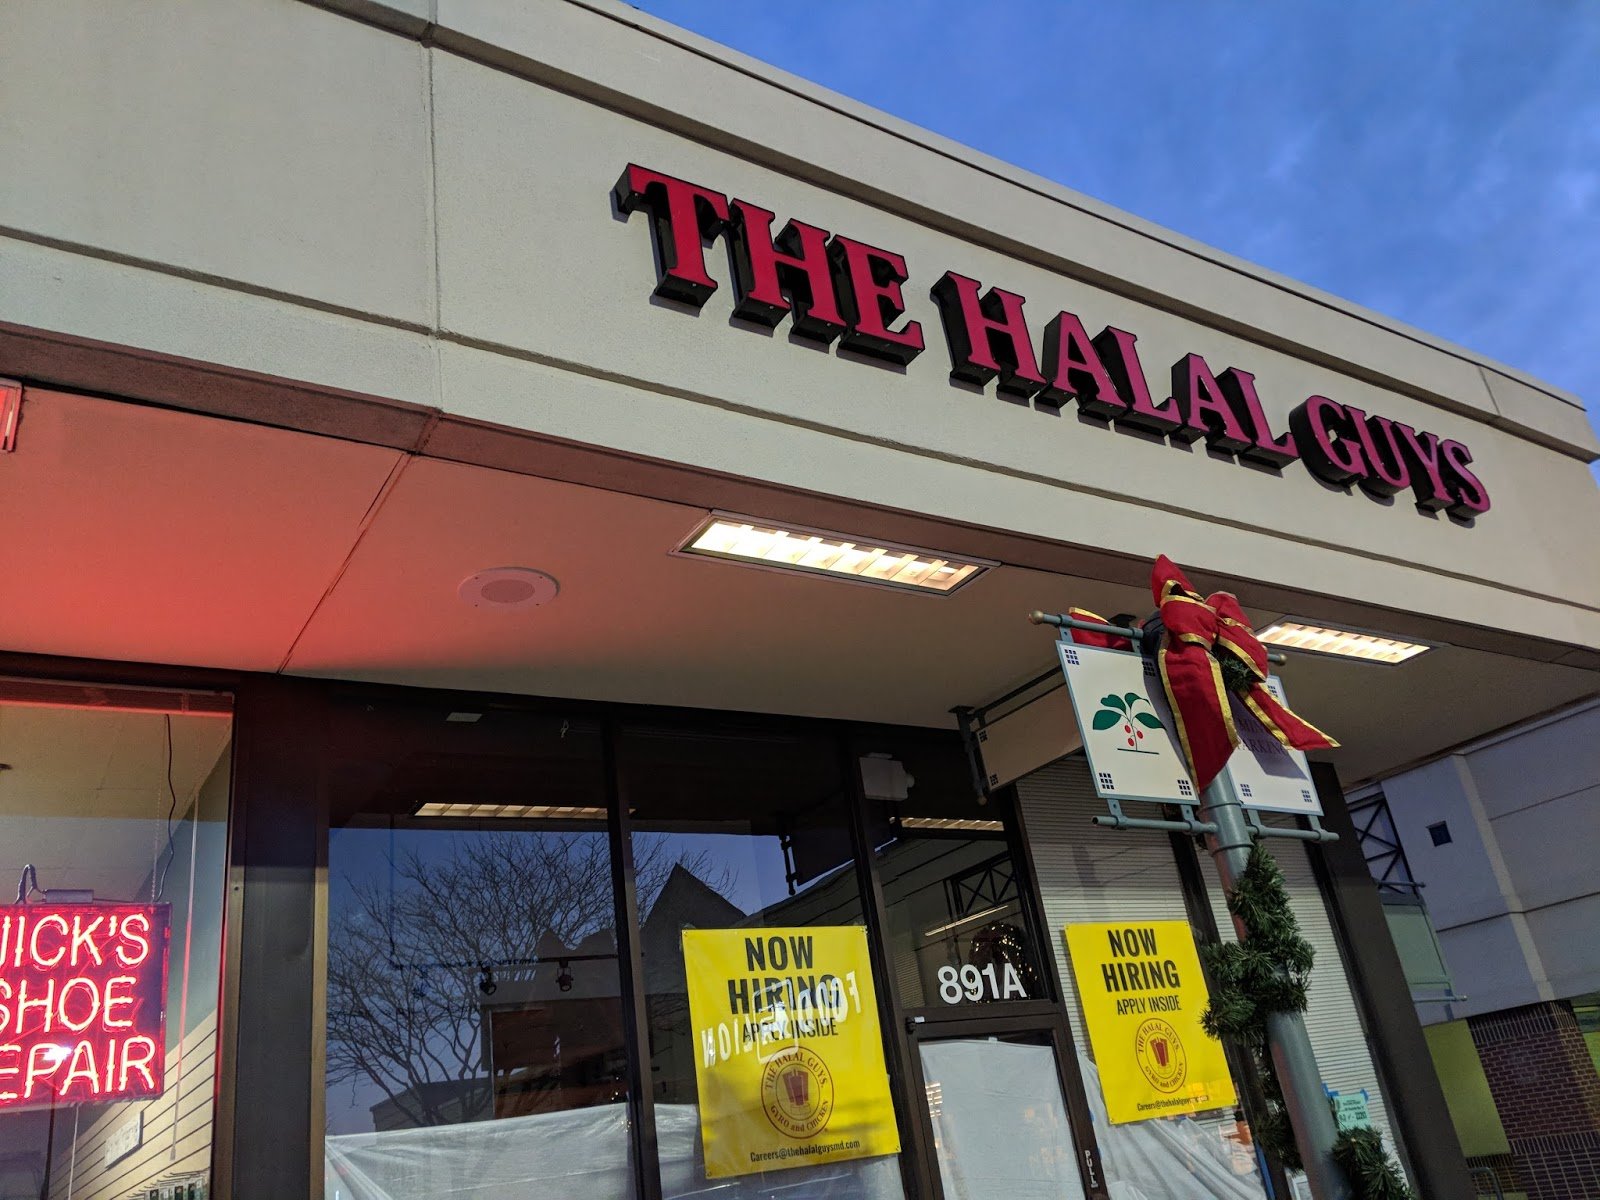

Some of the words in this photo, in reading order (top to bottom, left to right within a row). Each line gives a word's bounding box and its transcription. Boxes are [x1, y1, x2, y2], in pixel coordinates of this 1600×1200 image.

[626, 162, 925, 351] THE
[946, 271, 1300, 459] HALAL
[1302, 394, 1491, 513] GUYS
[744, 935, 814, 971] NOW
[1107, 928, 1158, 958] NOW
[727, 973, 842, 1014] HIRING
[937, 962, 1028, 1005] 891A
[1101, 959, 1181, 993] HIRING
[1116, 998, 1147, 1016] APPLY
[1148, 995, 1183, 1013] INSIDE
[743, 1019, 788, 1043] APL
[790, 1017, 839, 1040] INSIDE
[765, 1065, 778, 1090] THE
[774, 1051, 805, 1069] HALAL
[770, 1104, 790, 1128] GYRO
[790, 1123, 805, 1132] and
[806, 1098, 830, 1130] CHICKEN
[749, 1139, 861, 1163] Careers@thehalalguysmd.com
[1084, 1149, 1098, 1187] PULL
